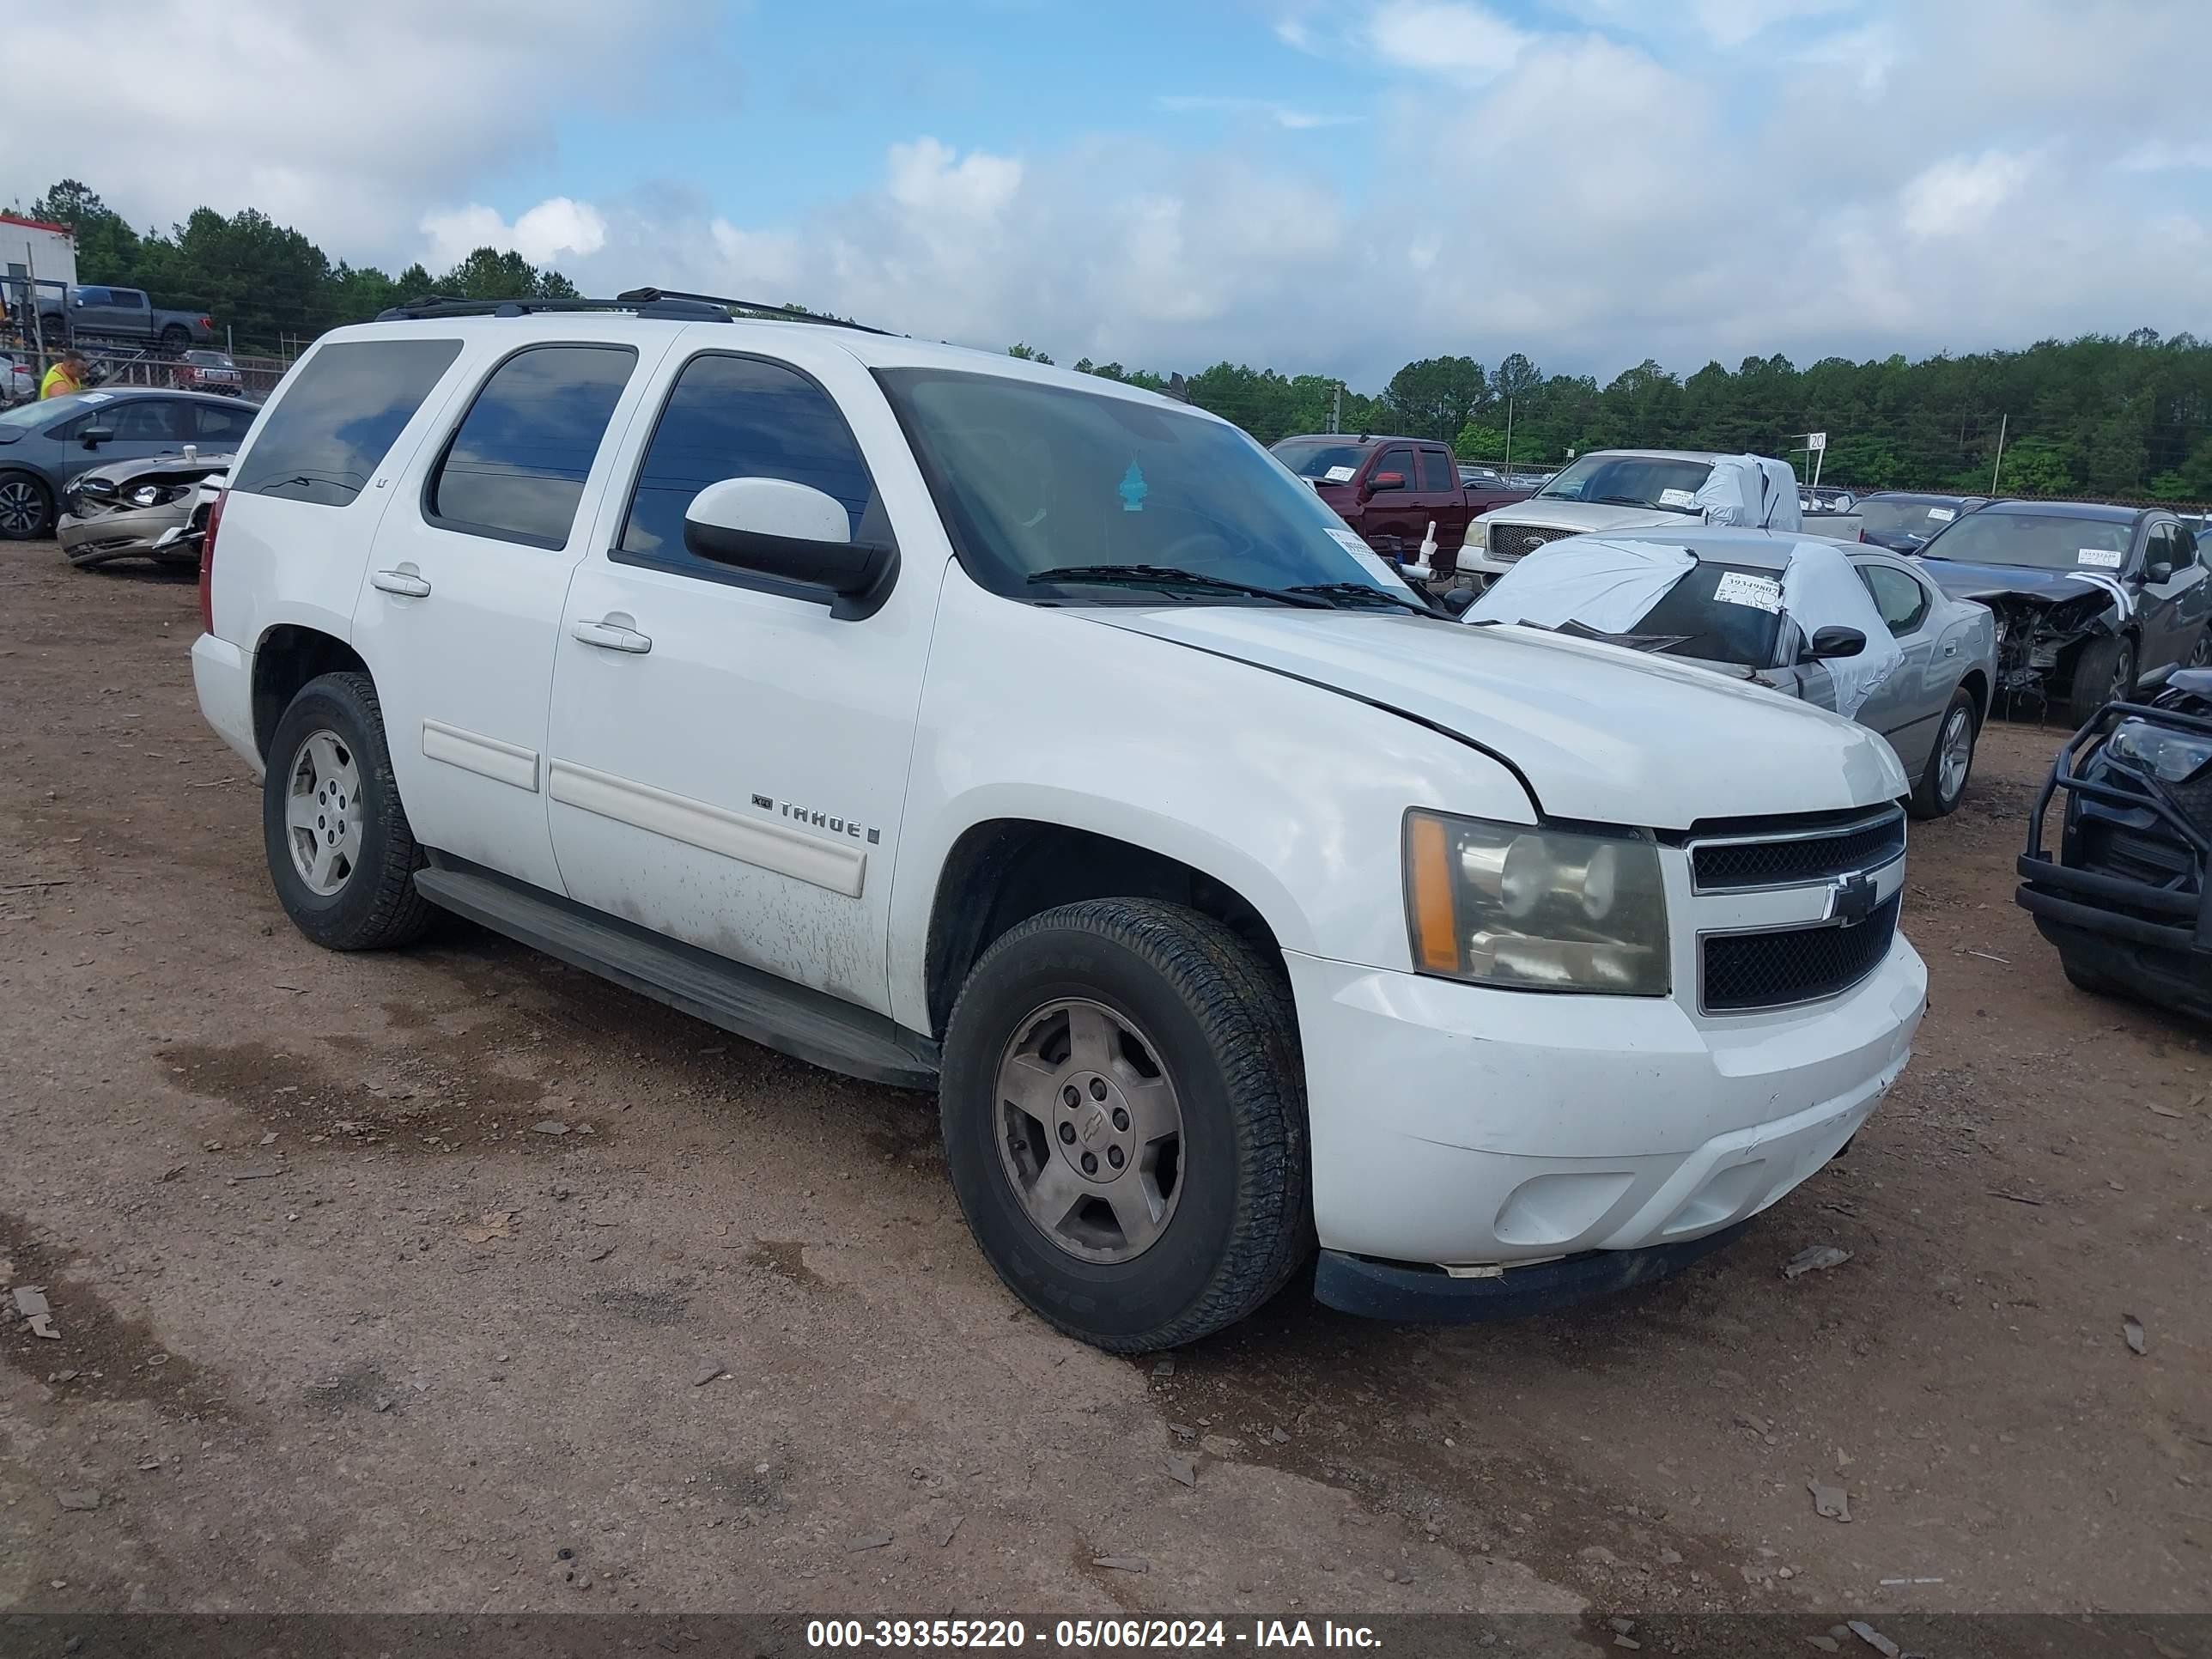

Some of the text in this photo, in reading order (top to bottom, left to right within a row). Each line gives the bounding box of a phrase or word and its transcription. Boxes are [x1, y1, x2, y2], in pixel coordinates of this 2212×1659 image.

[1812, 434, 1824, 448] 20
[1727, 578, 1779, 594] 39349807
[780, 799, 861, 838] TAHOE
